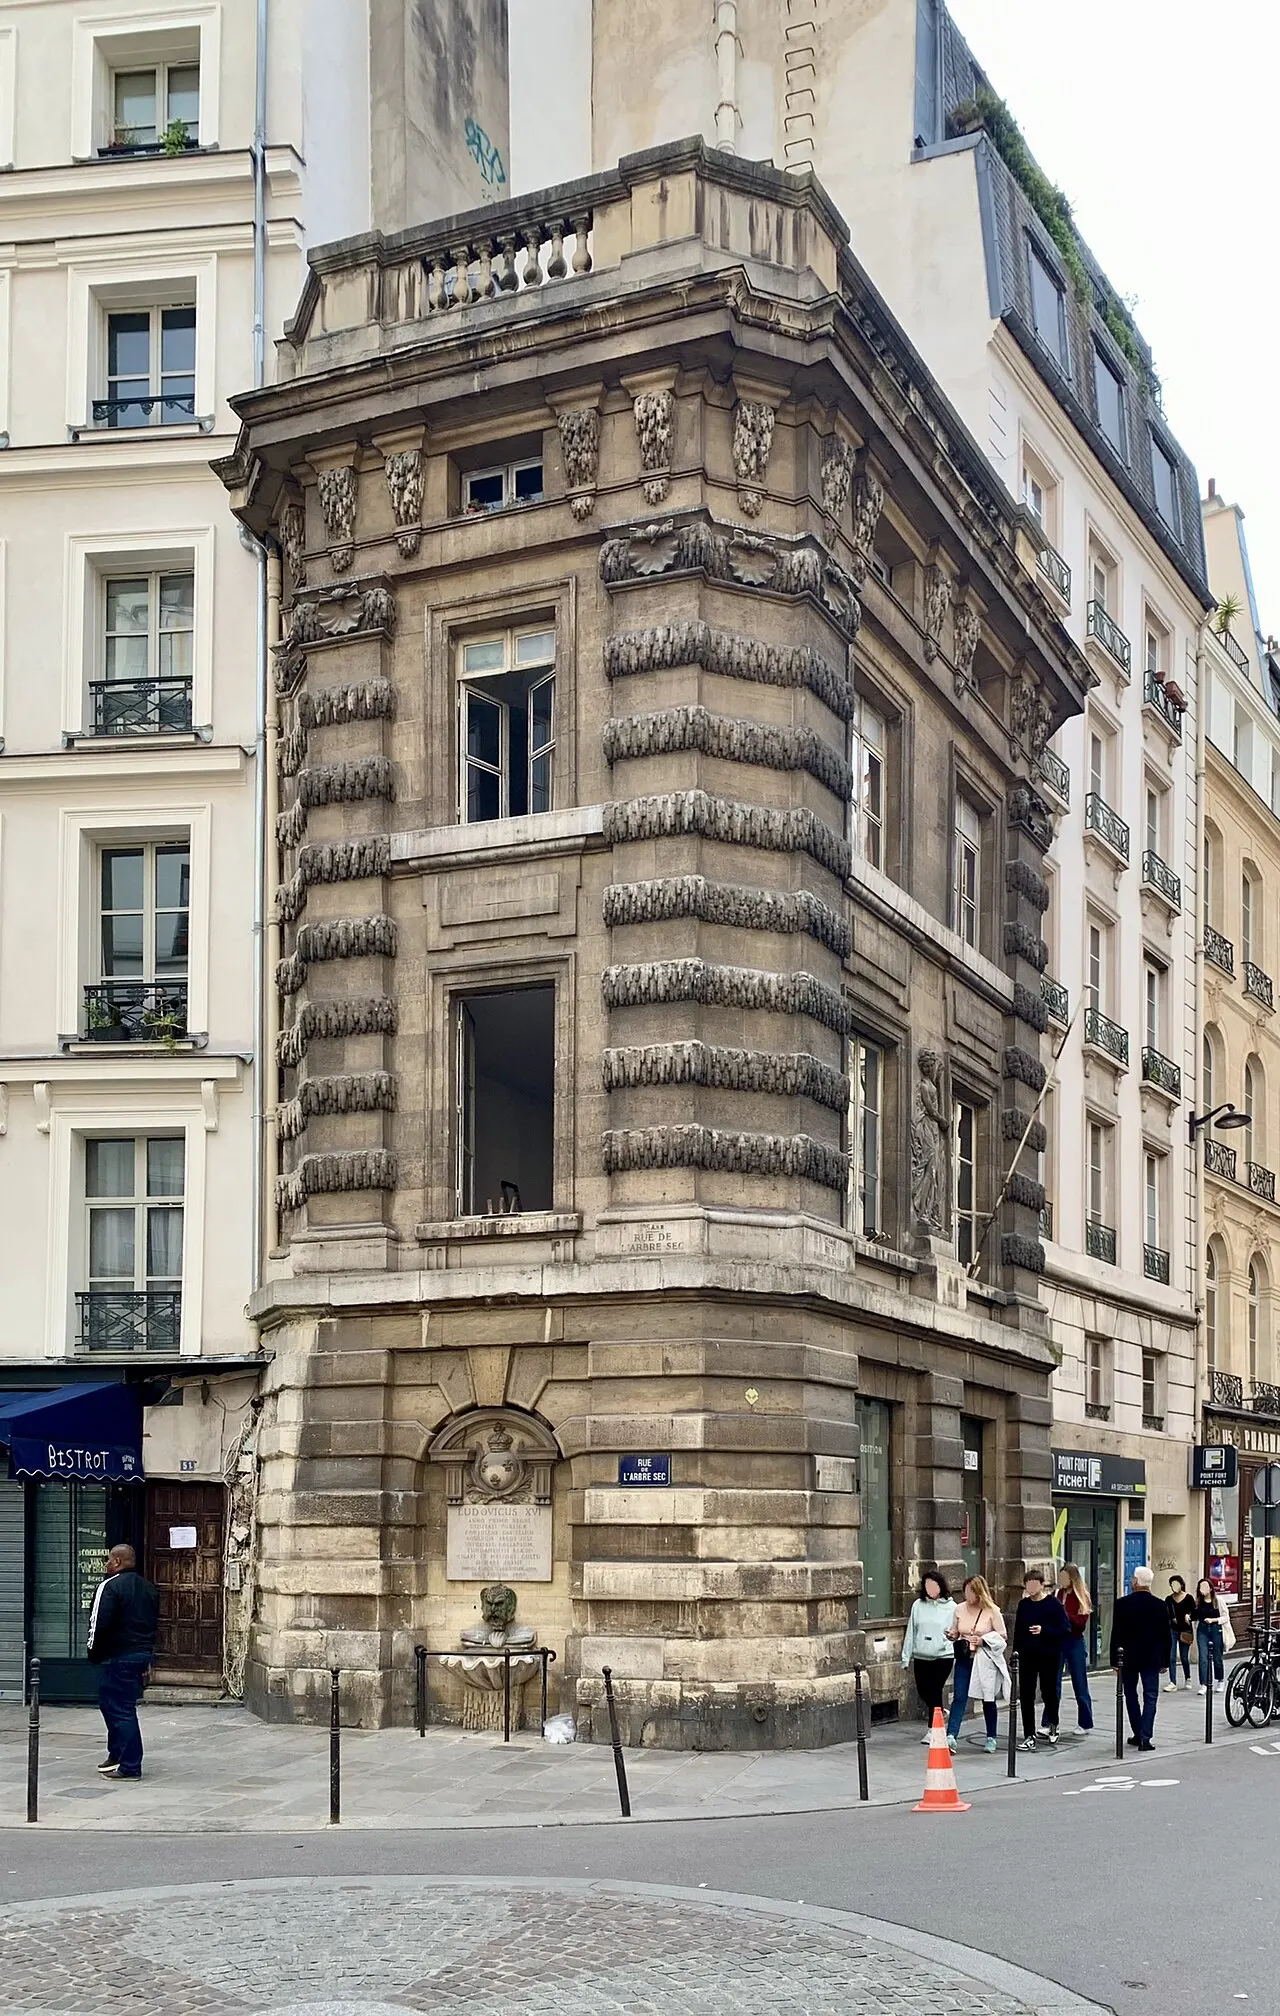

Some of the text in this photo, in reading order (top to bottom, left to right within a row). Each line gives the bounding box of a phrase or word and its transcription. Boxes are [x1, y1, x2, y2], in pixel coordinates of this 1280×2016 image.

[634, 1232, 672, 1242] RUE DE
[665, 1242, 685, 1250] SEC
[48, 1444, 109, 1470] BISTROT
[637, 1458, 652, 1467] RUE
[1058, 1455, 1088, 1472] POINT FORT
[623, 1472, 666, 1481] L'ARBRE SEC
[457, 1507, 542, 1516] LUDOVICUS XVI
